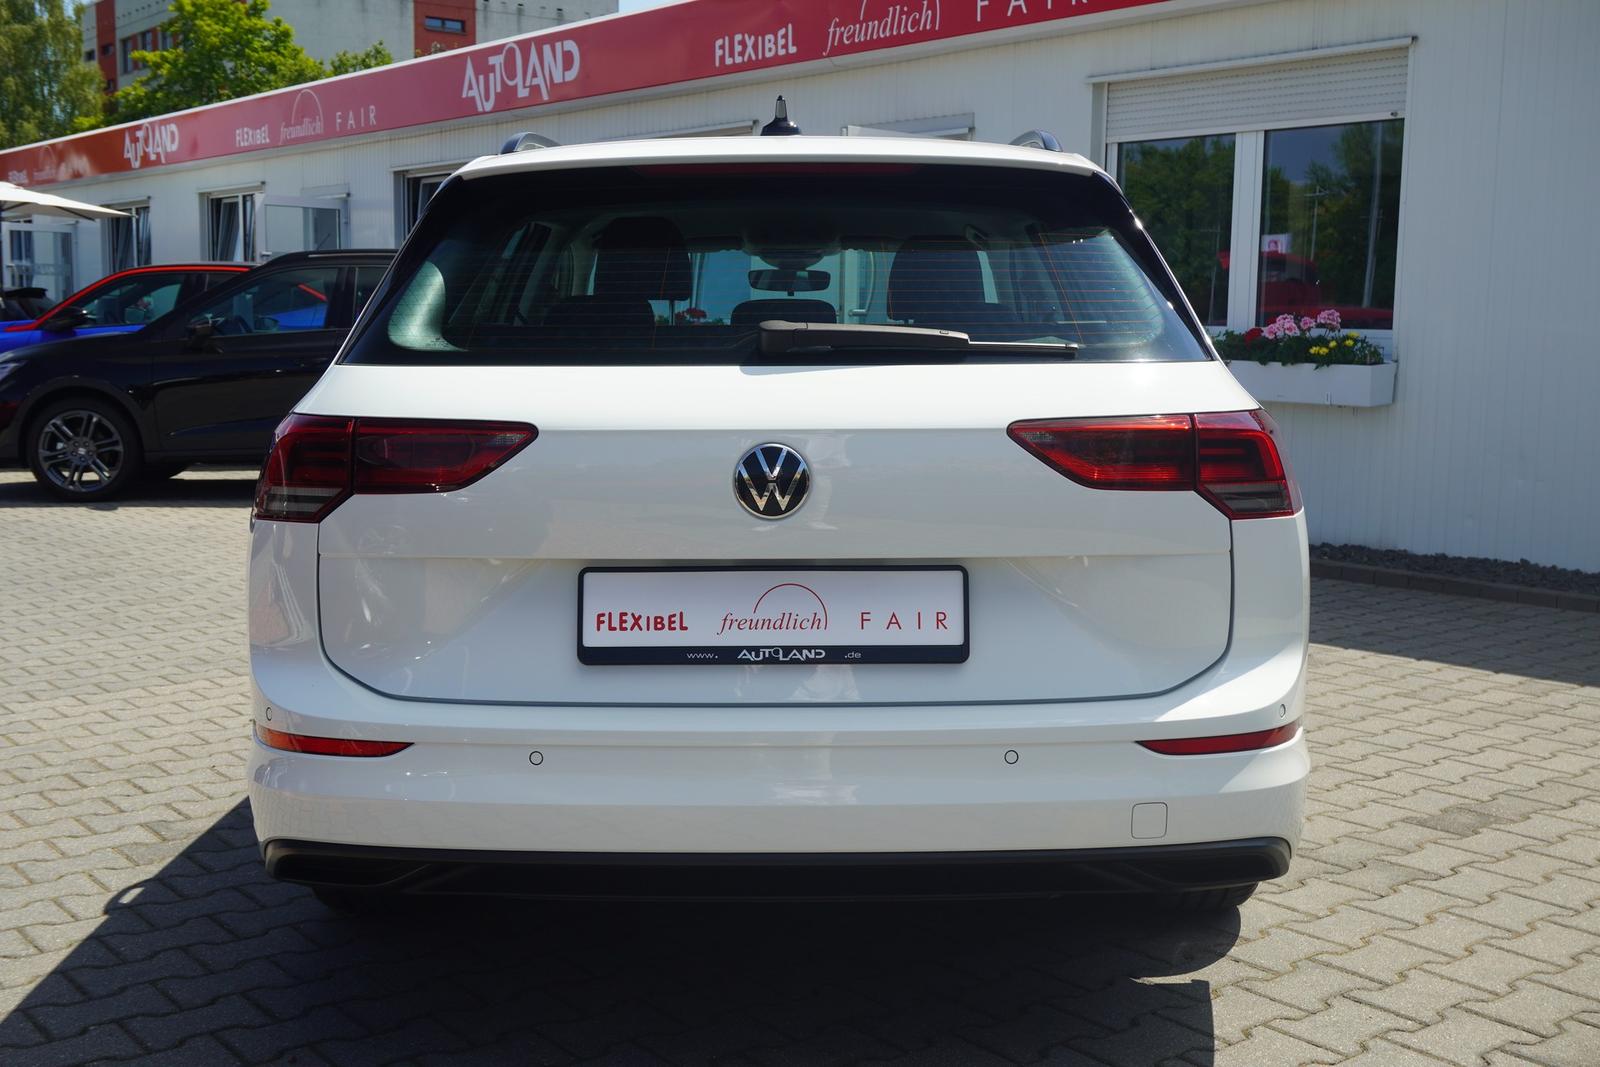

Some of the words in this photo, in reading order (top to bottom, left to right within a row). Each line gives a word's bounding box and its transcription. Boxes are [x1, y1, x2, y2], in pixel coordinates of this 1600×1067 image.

[714, 23, 798, 68] FLEXIBEL
[822, 0, 932, 56] freundlich
[461, 39, 580, 113] AUTOLAND
[123, 121, 180, 169] AUTOLAND
[235, 123, 271, 148] FLEXIBEL
[279, 115, 323, 146] freundlich
[335, 104, 377, 132] FAIR
[595, 611, 689, 632] FLEXIBEL
[716, 612, 822, 636] freundlich
[860, 611, 949, 631] FAIR
[736, 647, 826, 662] AUTOLAND
